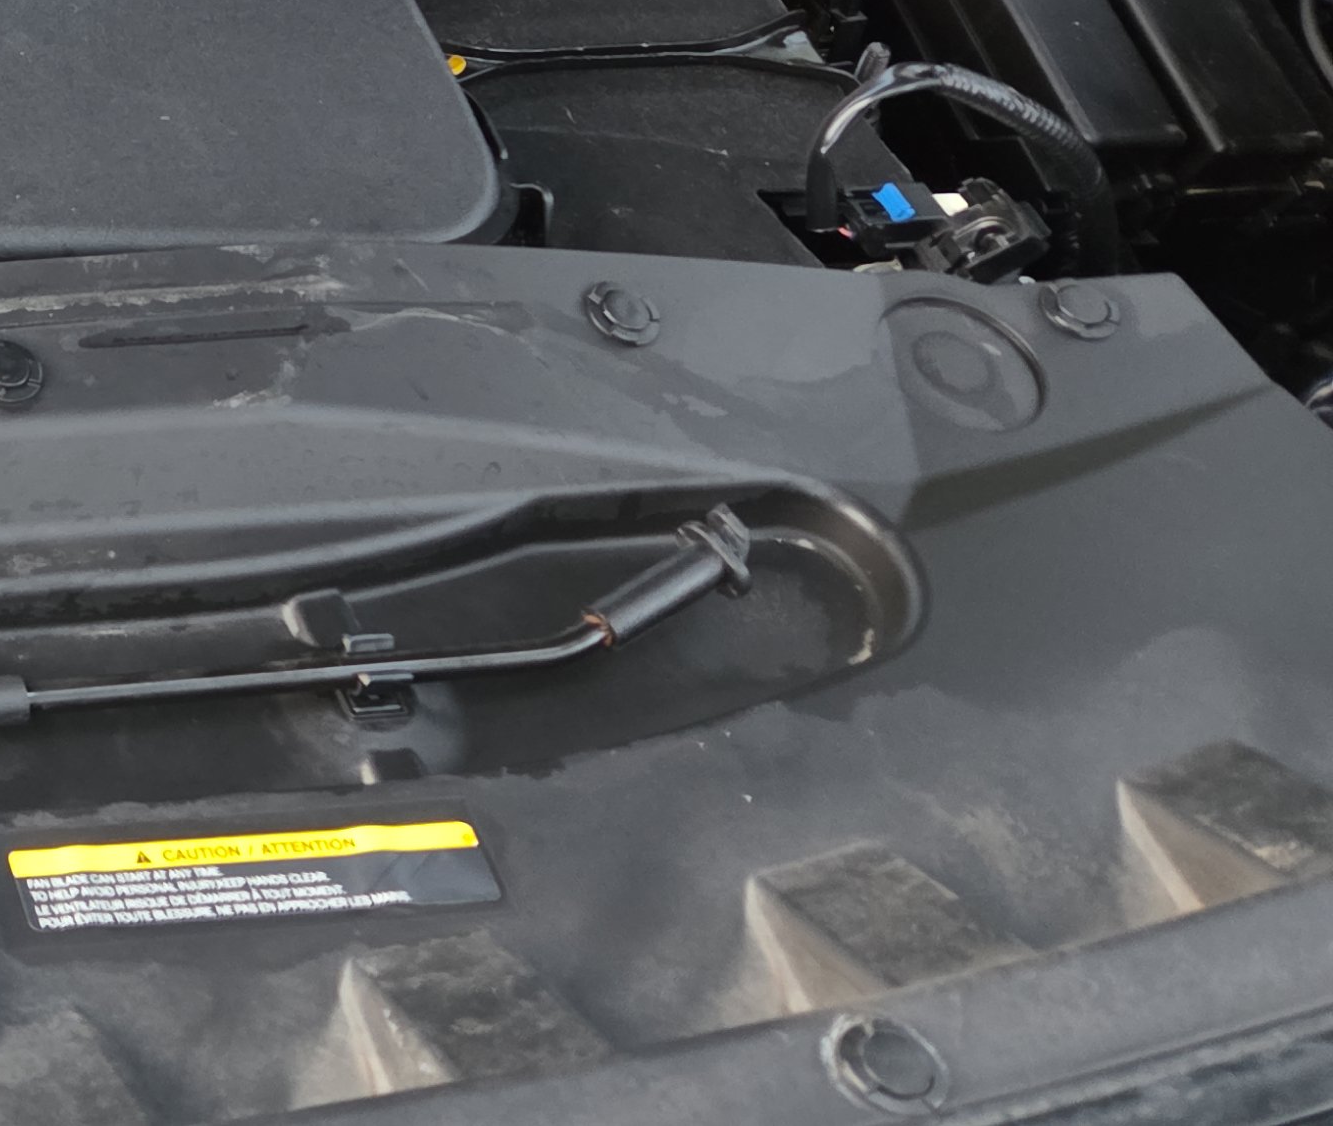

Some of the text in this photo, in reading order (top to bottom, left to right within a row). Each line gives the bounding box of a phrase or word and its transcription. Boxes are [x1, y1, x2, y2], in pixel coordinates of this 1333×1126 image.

[162, 845, 241, 861] CAUTION
[262, 838, 356, 855] ATTENTION
[89, 874, 116, 885] CAN
[30, 890, 48, 902] TO
[48, 887, 80, 901] HELP
[34, 904, 51, 916] LE
